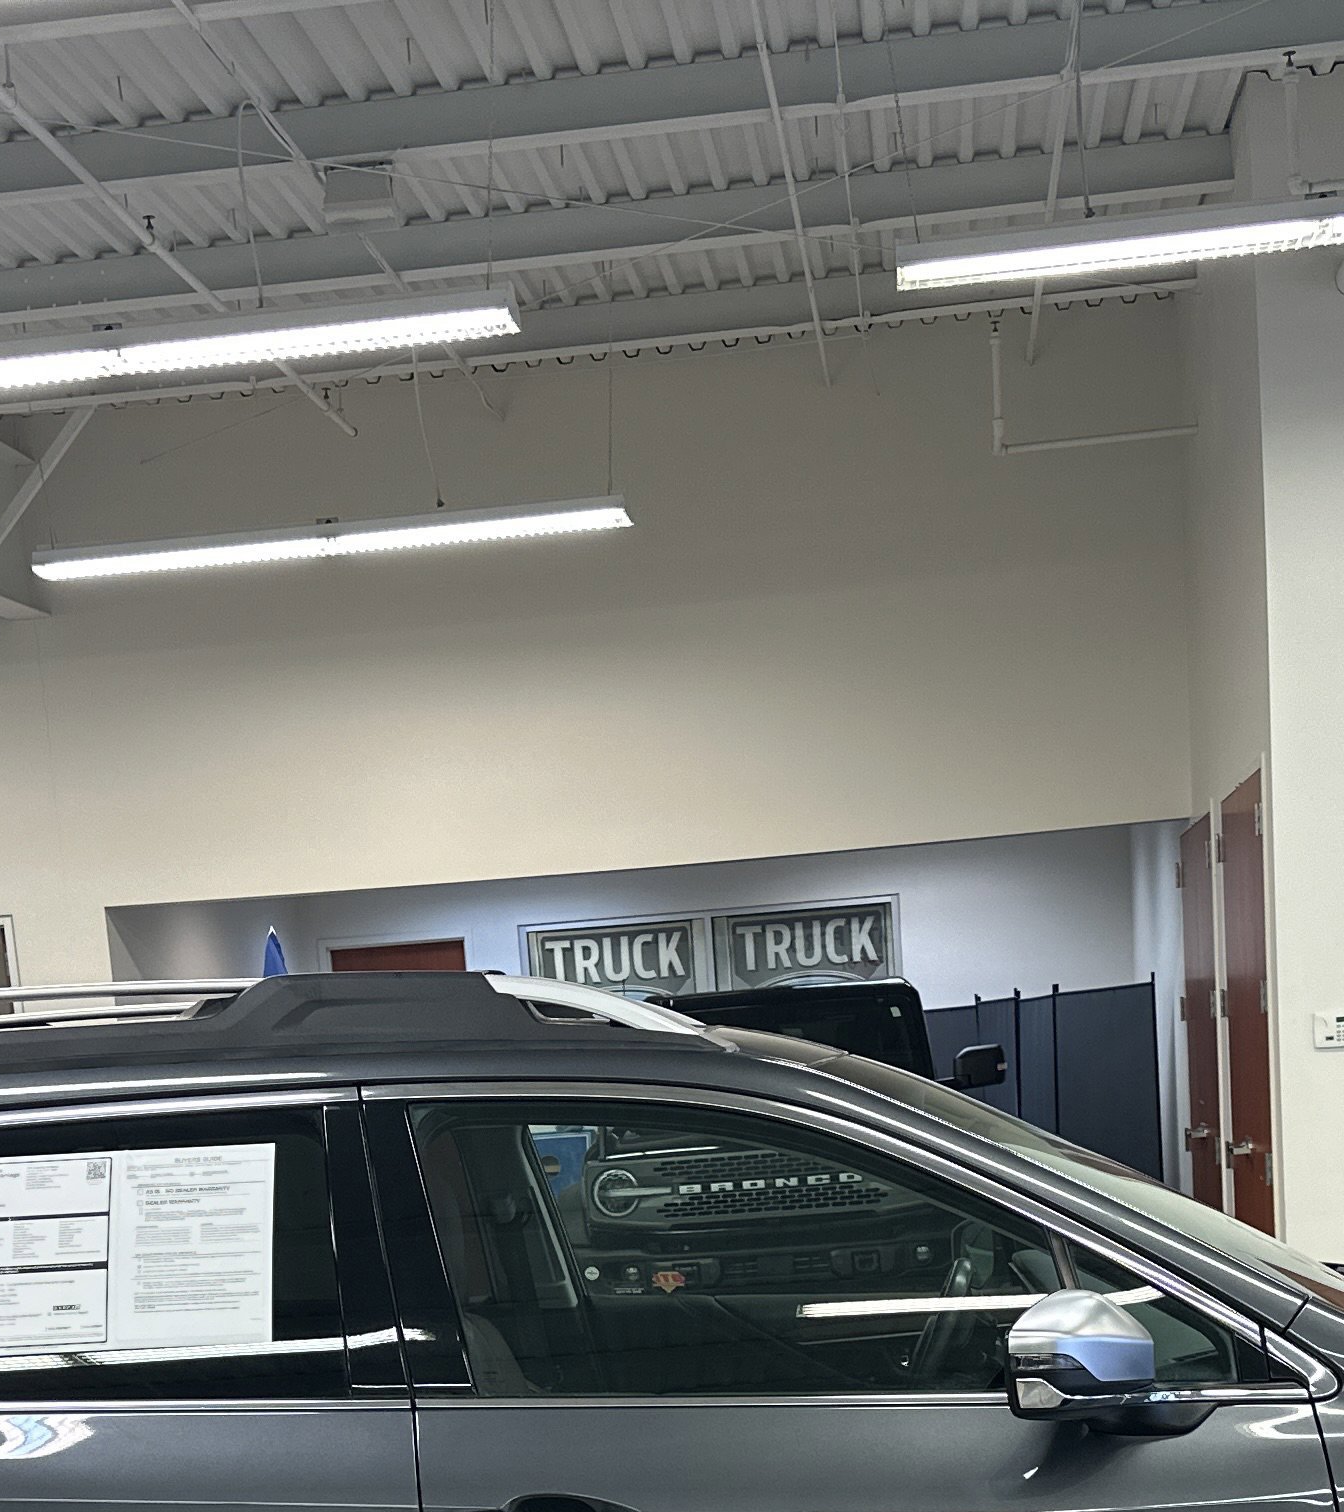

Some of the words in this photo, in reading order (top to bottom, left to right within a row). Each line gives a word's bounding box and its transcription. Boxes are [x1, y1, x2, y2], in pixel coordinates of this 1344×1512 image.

[544, 931, 686, 984] TRUCK
[735, 915, 879, 972] TRUCK
[678, 1172, 864, 1195] BRONCO
